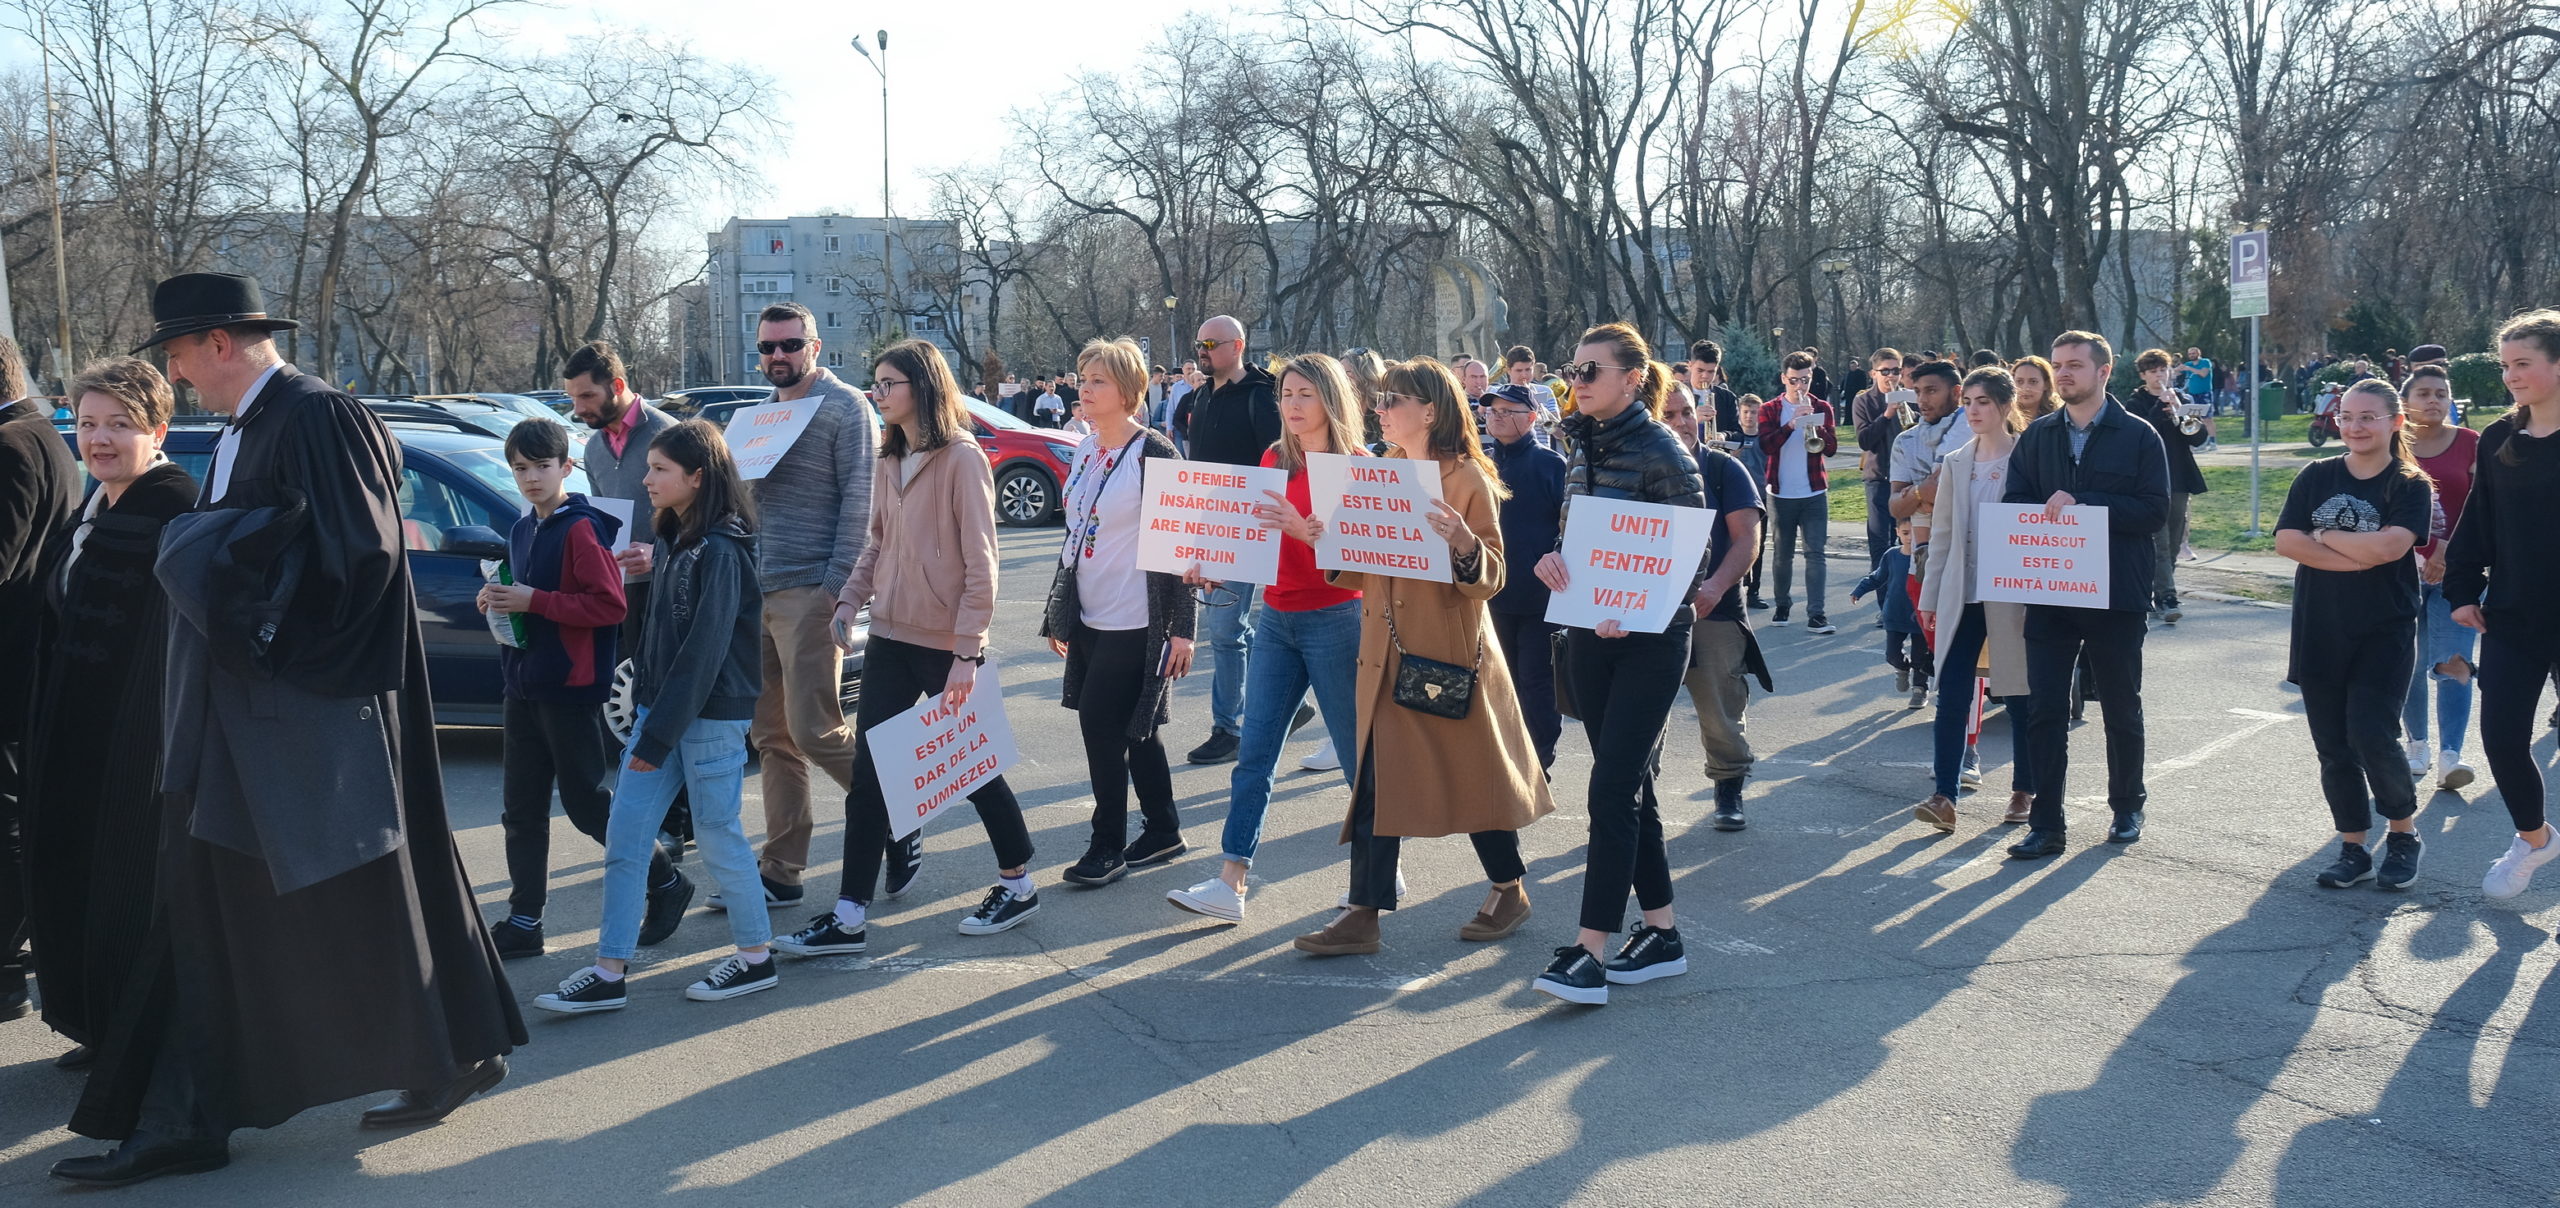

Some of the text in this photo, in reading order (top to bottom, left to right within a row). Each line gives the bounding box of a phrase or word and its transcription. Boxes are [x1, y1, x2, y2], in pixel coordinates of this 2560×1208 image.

[2239, 239, 2259, 277] P
[1177, 470, 1247, 489] O FEMEIE
[1350, 466, 1400, 488] VIAȚA
[1342, 494, 1412, 513] ESTE UN
[1150, 517, 1268, 542] ARE NEVOIE DE
[1339, 521, 1424, 542] DAR DE LA
[1610, 513, 1670, 543] UNIȚI
[2008, 533, 2087, 548] NENĂSCUT
[1174, 545, 1236, 564] SPRIJIN
[1340, 548, 1429, 571] DUMNEZEU
[1589, 549, 1673, 577] PENTRU
[2022, 556, 2074, 570] ESTE O
[1993, 576, 2098, 594] FIINȚĂ UMANĂ
[1592, 587, 1649, 615] VIAȚĂ
[914, 711, 977, 761] ESTE UN
[913, 732, 989, 791] DAR DE LA
[916, 754, 999, 817] DUMNEZEU
